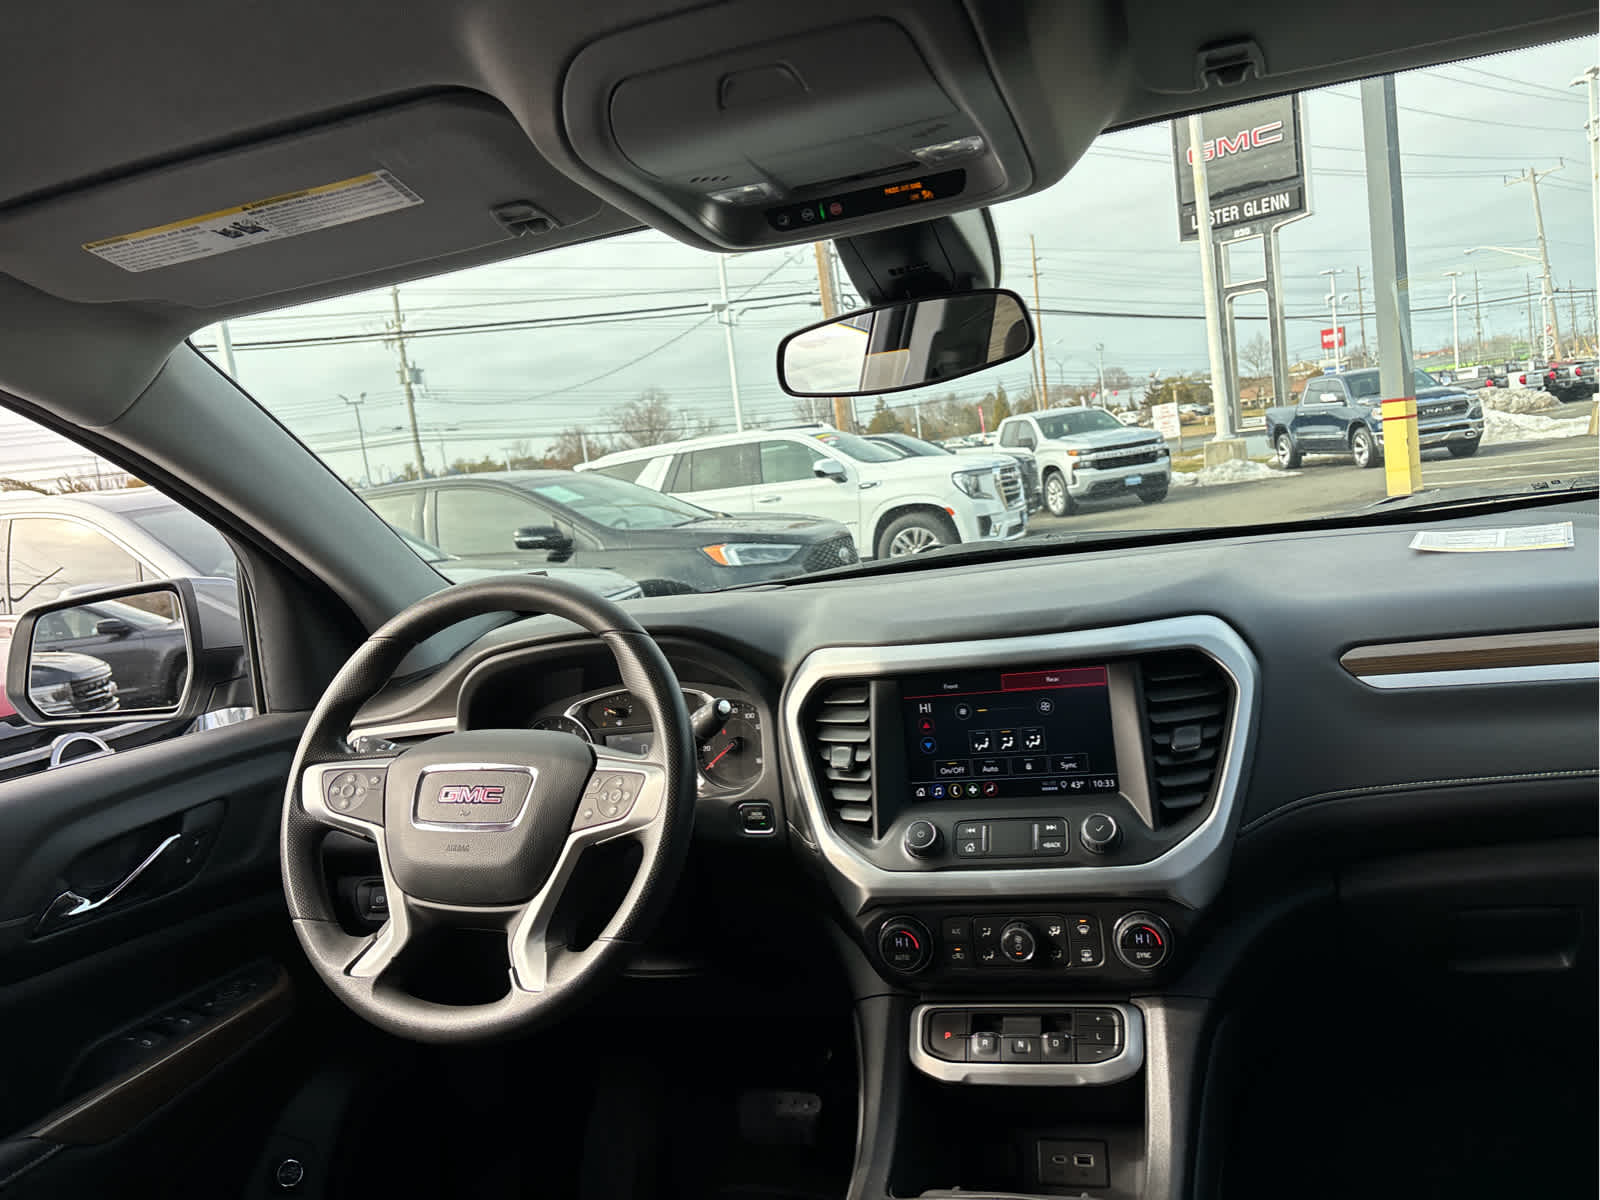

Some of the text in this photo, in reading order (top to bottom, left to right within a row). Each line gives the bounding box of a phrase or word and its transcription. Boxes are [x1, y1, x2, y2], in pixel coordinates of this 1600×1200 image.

[1186, 120, 1283, 165] GMC
[1191, 192, 1291, 231] LSTER GLENN
[918, 703, 932, 714] HI
[1060, 761, 1078, 770] Sync
[1093, 779, 1115, 788] 10:33
[438, 785, 505, 804] GMC
[1136, 951, 1152, 959] SYNC
[944, 1032, 952, 1040] P
[982, 1039, 1059, 1048] R N D
